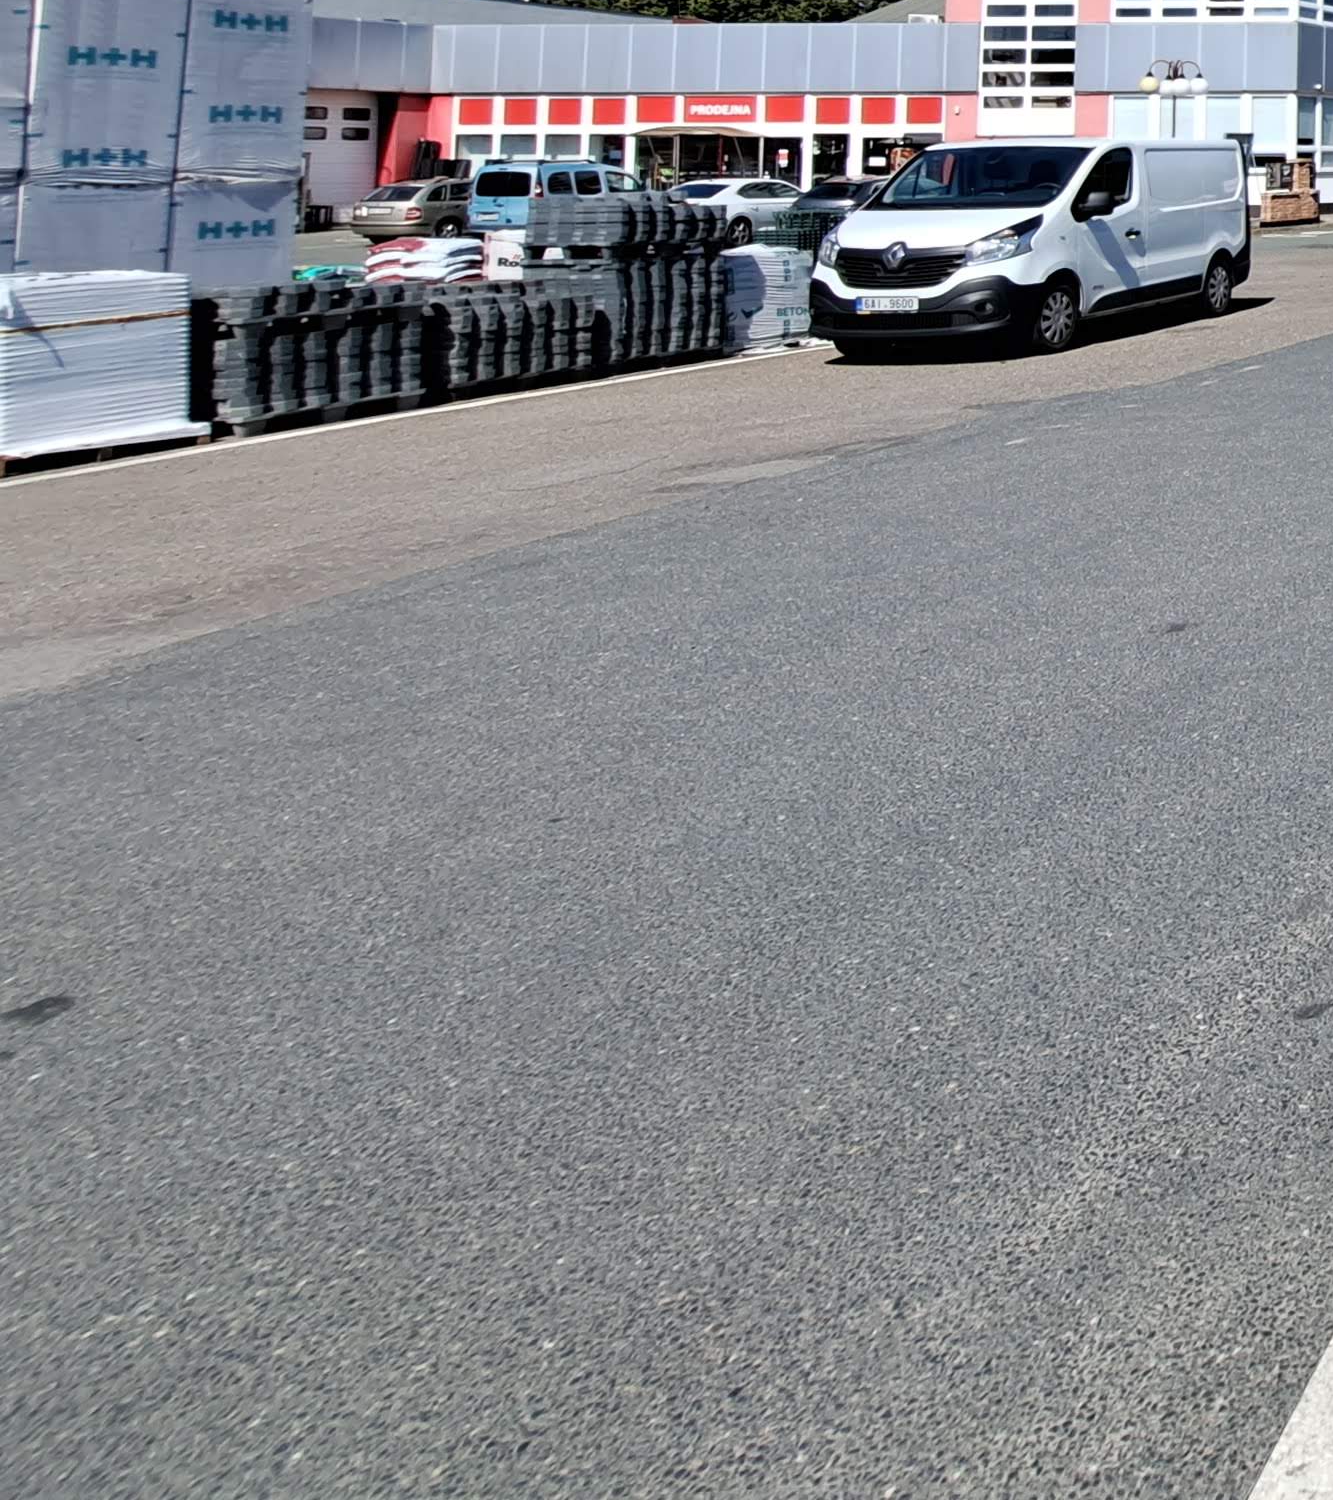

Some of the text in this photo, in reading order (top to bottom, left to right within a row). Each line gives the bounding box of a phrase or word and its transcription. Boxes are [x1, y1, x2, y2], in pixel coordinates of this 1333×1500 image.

[213, 9, 289, 32] H+H
[67, 46, 158, 68] H+H
[208, 104, 283, 124] H+H
[690, 104, 752, 116] PRODEJNA
[62, 148, 147, 168] H+H
[197, 219, 276, 240] H+H
